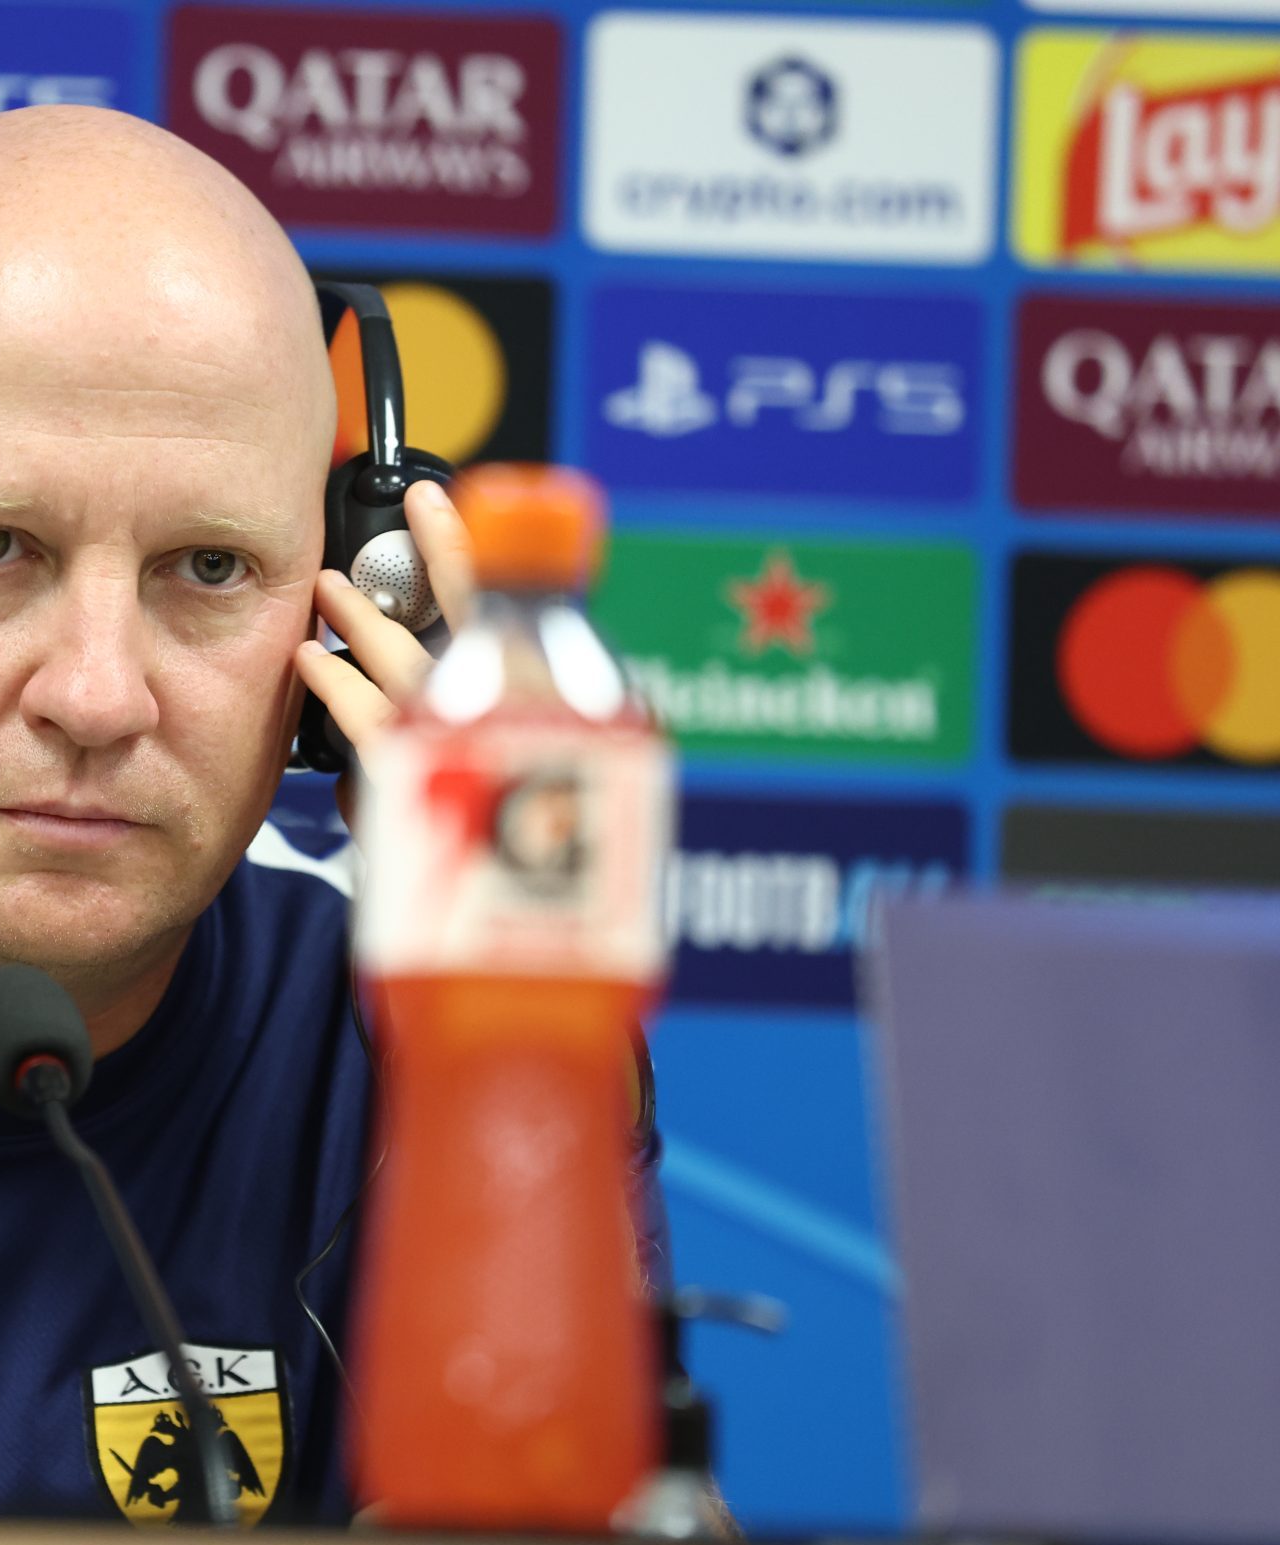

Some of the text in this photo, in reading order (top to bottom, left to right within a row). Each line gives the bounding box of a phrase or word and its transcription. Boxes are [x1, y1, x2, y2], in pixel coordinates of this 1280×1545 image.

[193, 43, 526, 151] QATAR
[617, 172, 964, 230] crypto.com
[1099, 82, 1280, 230] Lay
[726, 356, 966, 435] PS5
[1042, 328, 1280, 441] QATA
